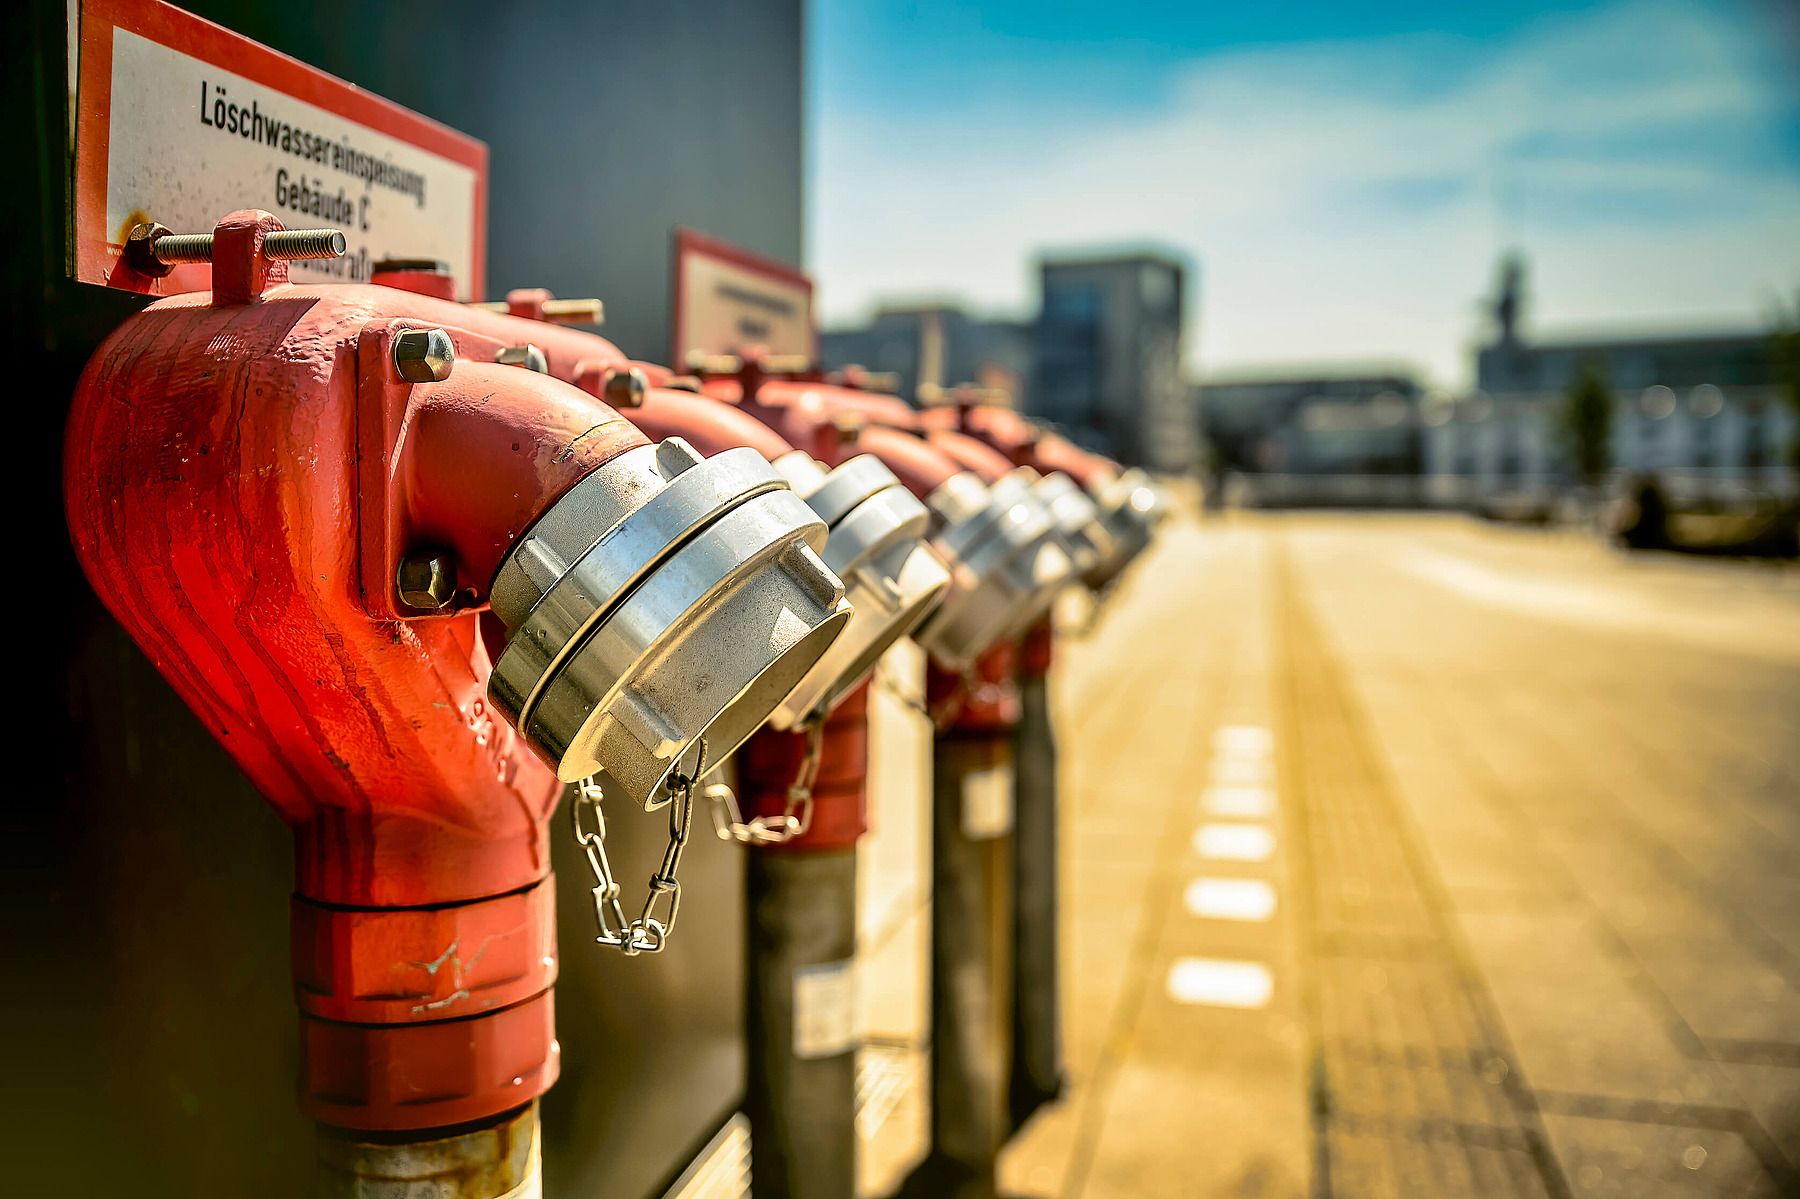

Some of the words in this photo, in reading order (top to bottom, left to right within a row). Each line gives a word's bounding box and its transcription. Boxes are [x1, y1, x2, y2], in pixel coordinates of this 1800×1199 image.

[200, 80, 426, 208] Löschwassereinspeisung
[275, 167, 353, 226] Gebäude
[357, 194, 371, 232] C
